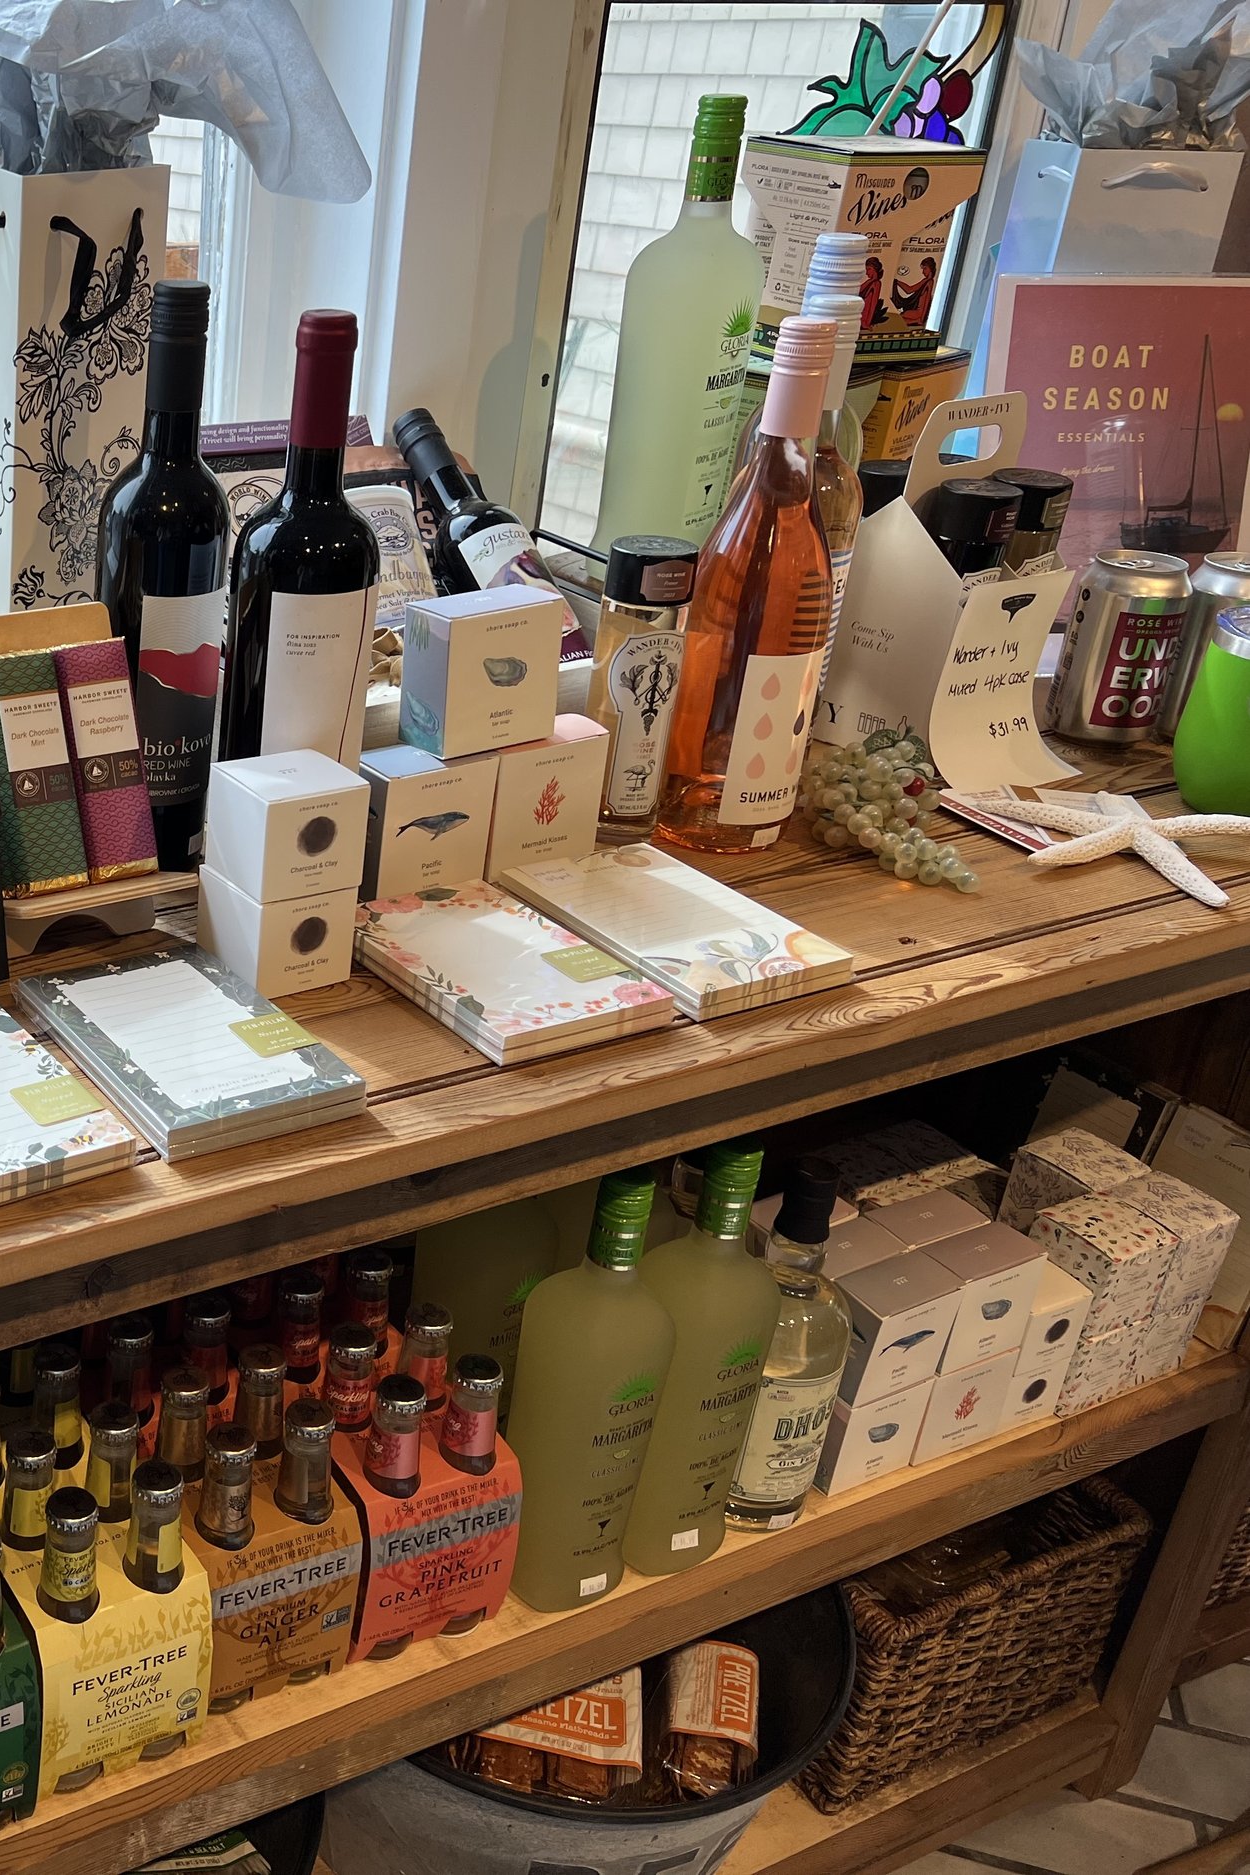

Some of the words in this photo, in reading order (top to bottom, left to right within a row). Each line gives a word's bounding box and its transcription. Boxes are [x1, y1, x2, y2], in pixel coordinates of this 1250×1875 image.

[855, 173, 896, 188] MISGUIDED
[847, 190, 907, 226] Vines
[908, 237, 945, 245] FLORA
[720, 336, 750, 352] GLORIA
[1069, 345, 1154, 368] BOAT
[1043, 387, 1169, 411] SEASON
[218, 427, 237, 436] design
[250, 424, 289, 435] functionality
[1057, 432, 1146, 443] ESSENTIALS
[851, 620, 877, 637] Come
[877, 627, 895, 642] Sip
[851, 635, 874, 650] With
[876, 641, 890, 654] Us
[953, 645, 989, 664] Wander
[1001, 640, 1019, 662] Ivy
[948, 679, 978, 696] Mixed
[1009, 670, 1030, 685] case
[80, 718, 96, 728] Dark
[97, 712, 129, 726] Chocolate
[489, 708, 513, 719] Atlantic
[11, 731, 28, 742] Dark
[29, 726, 59, 739] Chocolate
[90, 724, 124, 737] Raspberry
[989, 717, 1029, 738] $31.99
[31, 738, 45, 747] Mint
[119, 759, 138, 771] 50%
[144, 760, 166, 771] RED
[168, 757, 191, 771] WINE
[739, 788, 789, 803] SUMMER
[521, 838, 547, 850] Mermaid
[548, 834, 568, 844] Kisses
[290, 864, 317, 875] Charcoal
[325, 859, 338, 869] Clay
[421, 859, 443, 870] Pacific
[717, 1358, 760, 1382] GLORIA
[326, 1386, 370, 1403] Sparkling
[700, 1382, 757, 1412] MARGARITA
[608, 1394, 655, 1417] GLORIA
[591, 1417, 654, 1448] MARGARITA
[591, 1464, 624, 1479] CLASSIC
[388, 1508, 508, 1557] FEVER-TREE
[417, 1546, 474, 1570] SPARKLING
[421, 1558, 467, 1583] PINK
[220, 1557, 347, 1610] FEVER-TREE
[379, 1559, 502, 1608] GRAPEFRUIT
[257, 1599, 307, 1620] PREMIUM
[240, 1603, 319, 1640] GINGER
[259, 1625, 297, 1648] ALE
[72, 1645, 188, 1696] FEVER-TREE
[97, 1671, 162, 1703] Sparkling
[719, 1660, 751, 1723] PRETZEL
[86, 1688, 173, 1727] LEMONADE
[104, 1686, 157, 1711] SICILIAN
[559, 1722, 610, 1740] Flatbreads
